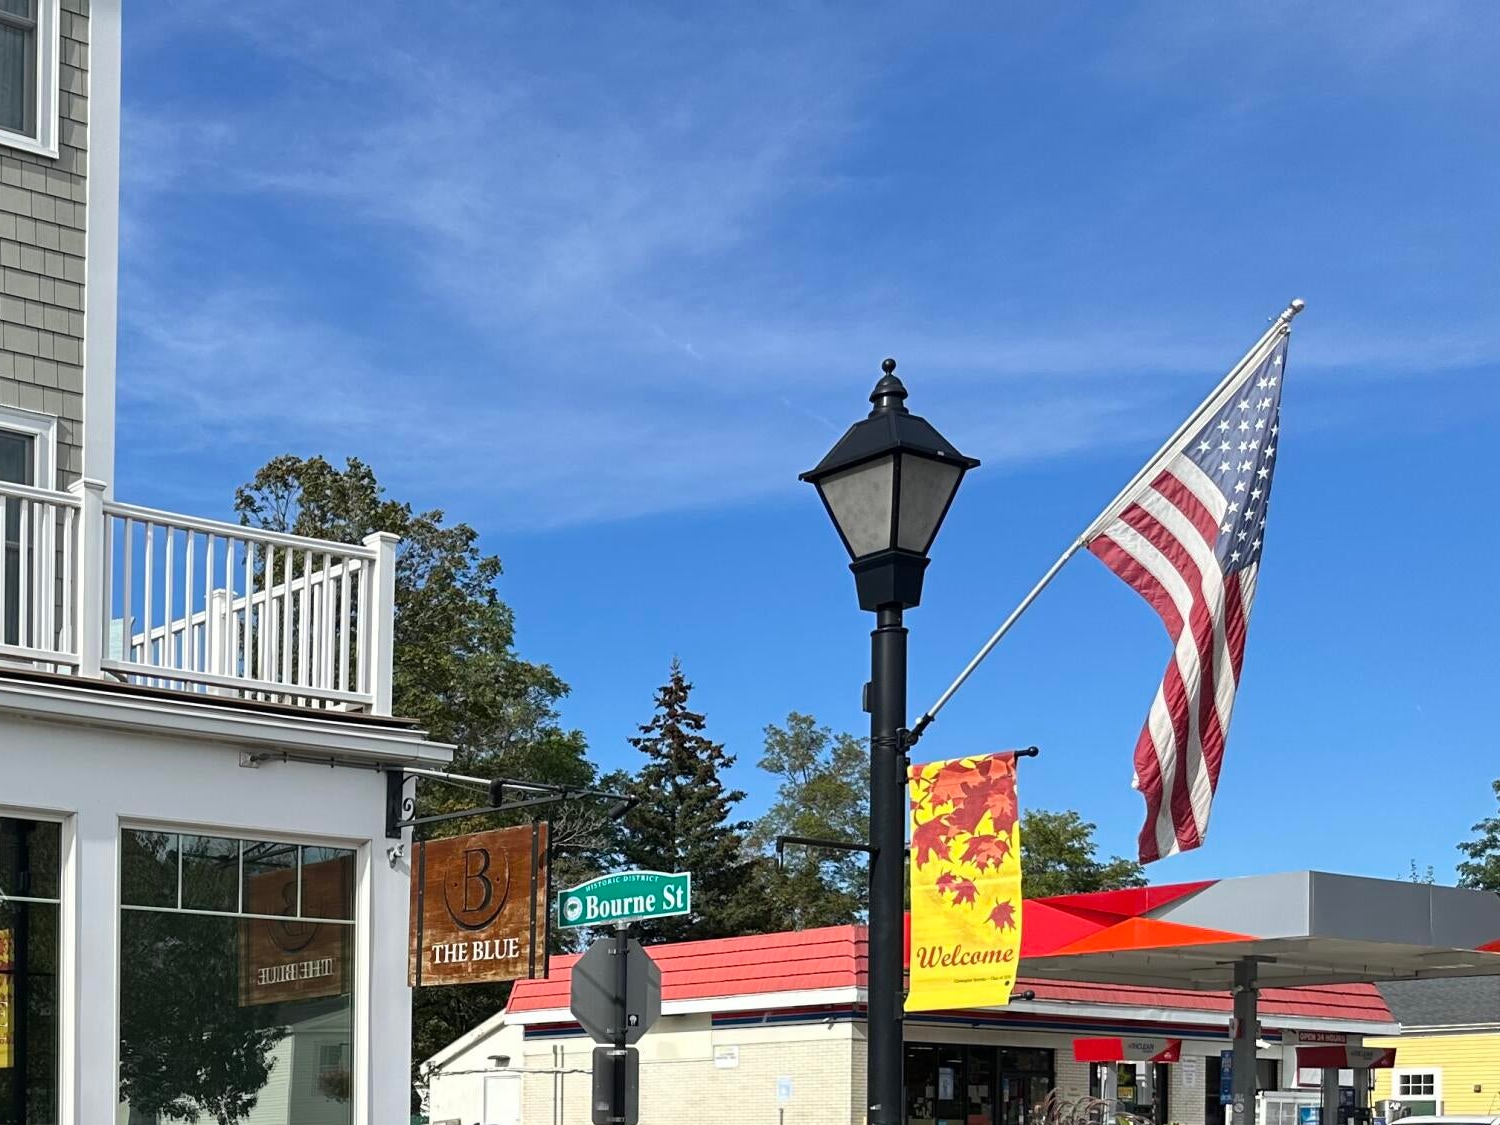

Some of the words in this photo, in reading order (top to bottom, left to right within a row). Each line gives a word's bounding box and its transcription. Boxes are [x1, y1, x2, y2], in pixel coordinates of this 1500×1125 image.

[464, 848, 493, 913] B
[585, 876, 620, 893] HISTORIC
[623, 874, 660, 883] DISTRICT
[586, 894, 656, 920] Bourne
[663, 883, 684, 911] St
[432, 943, 469, 964] THE
[472, 937, 520, 961] BLUE
[916, 944, 1014, 969] Welcome
[1300, 1032, 1316, 1040] OPEN
[1317, 1033, 1325, 1041] 24
[1326, 1034, 1345, 1043] HOURS
